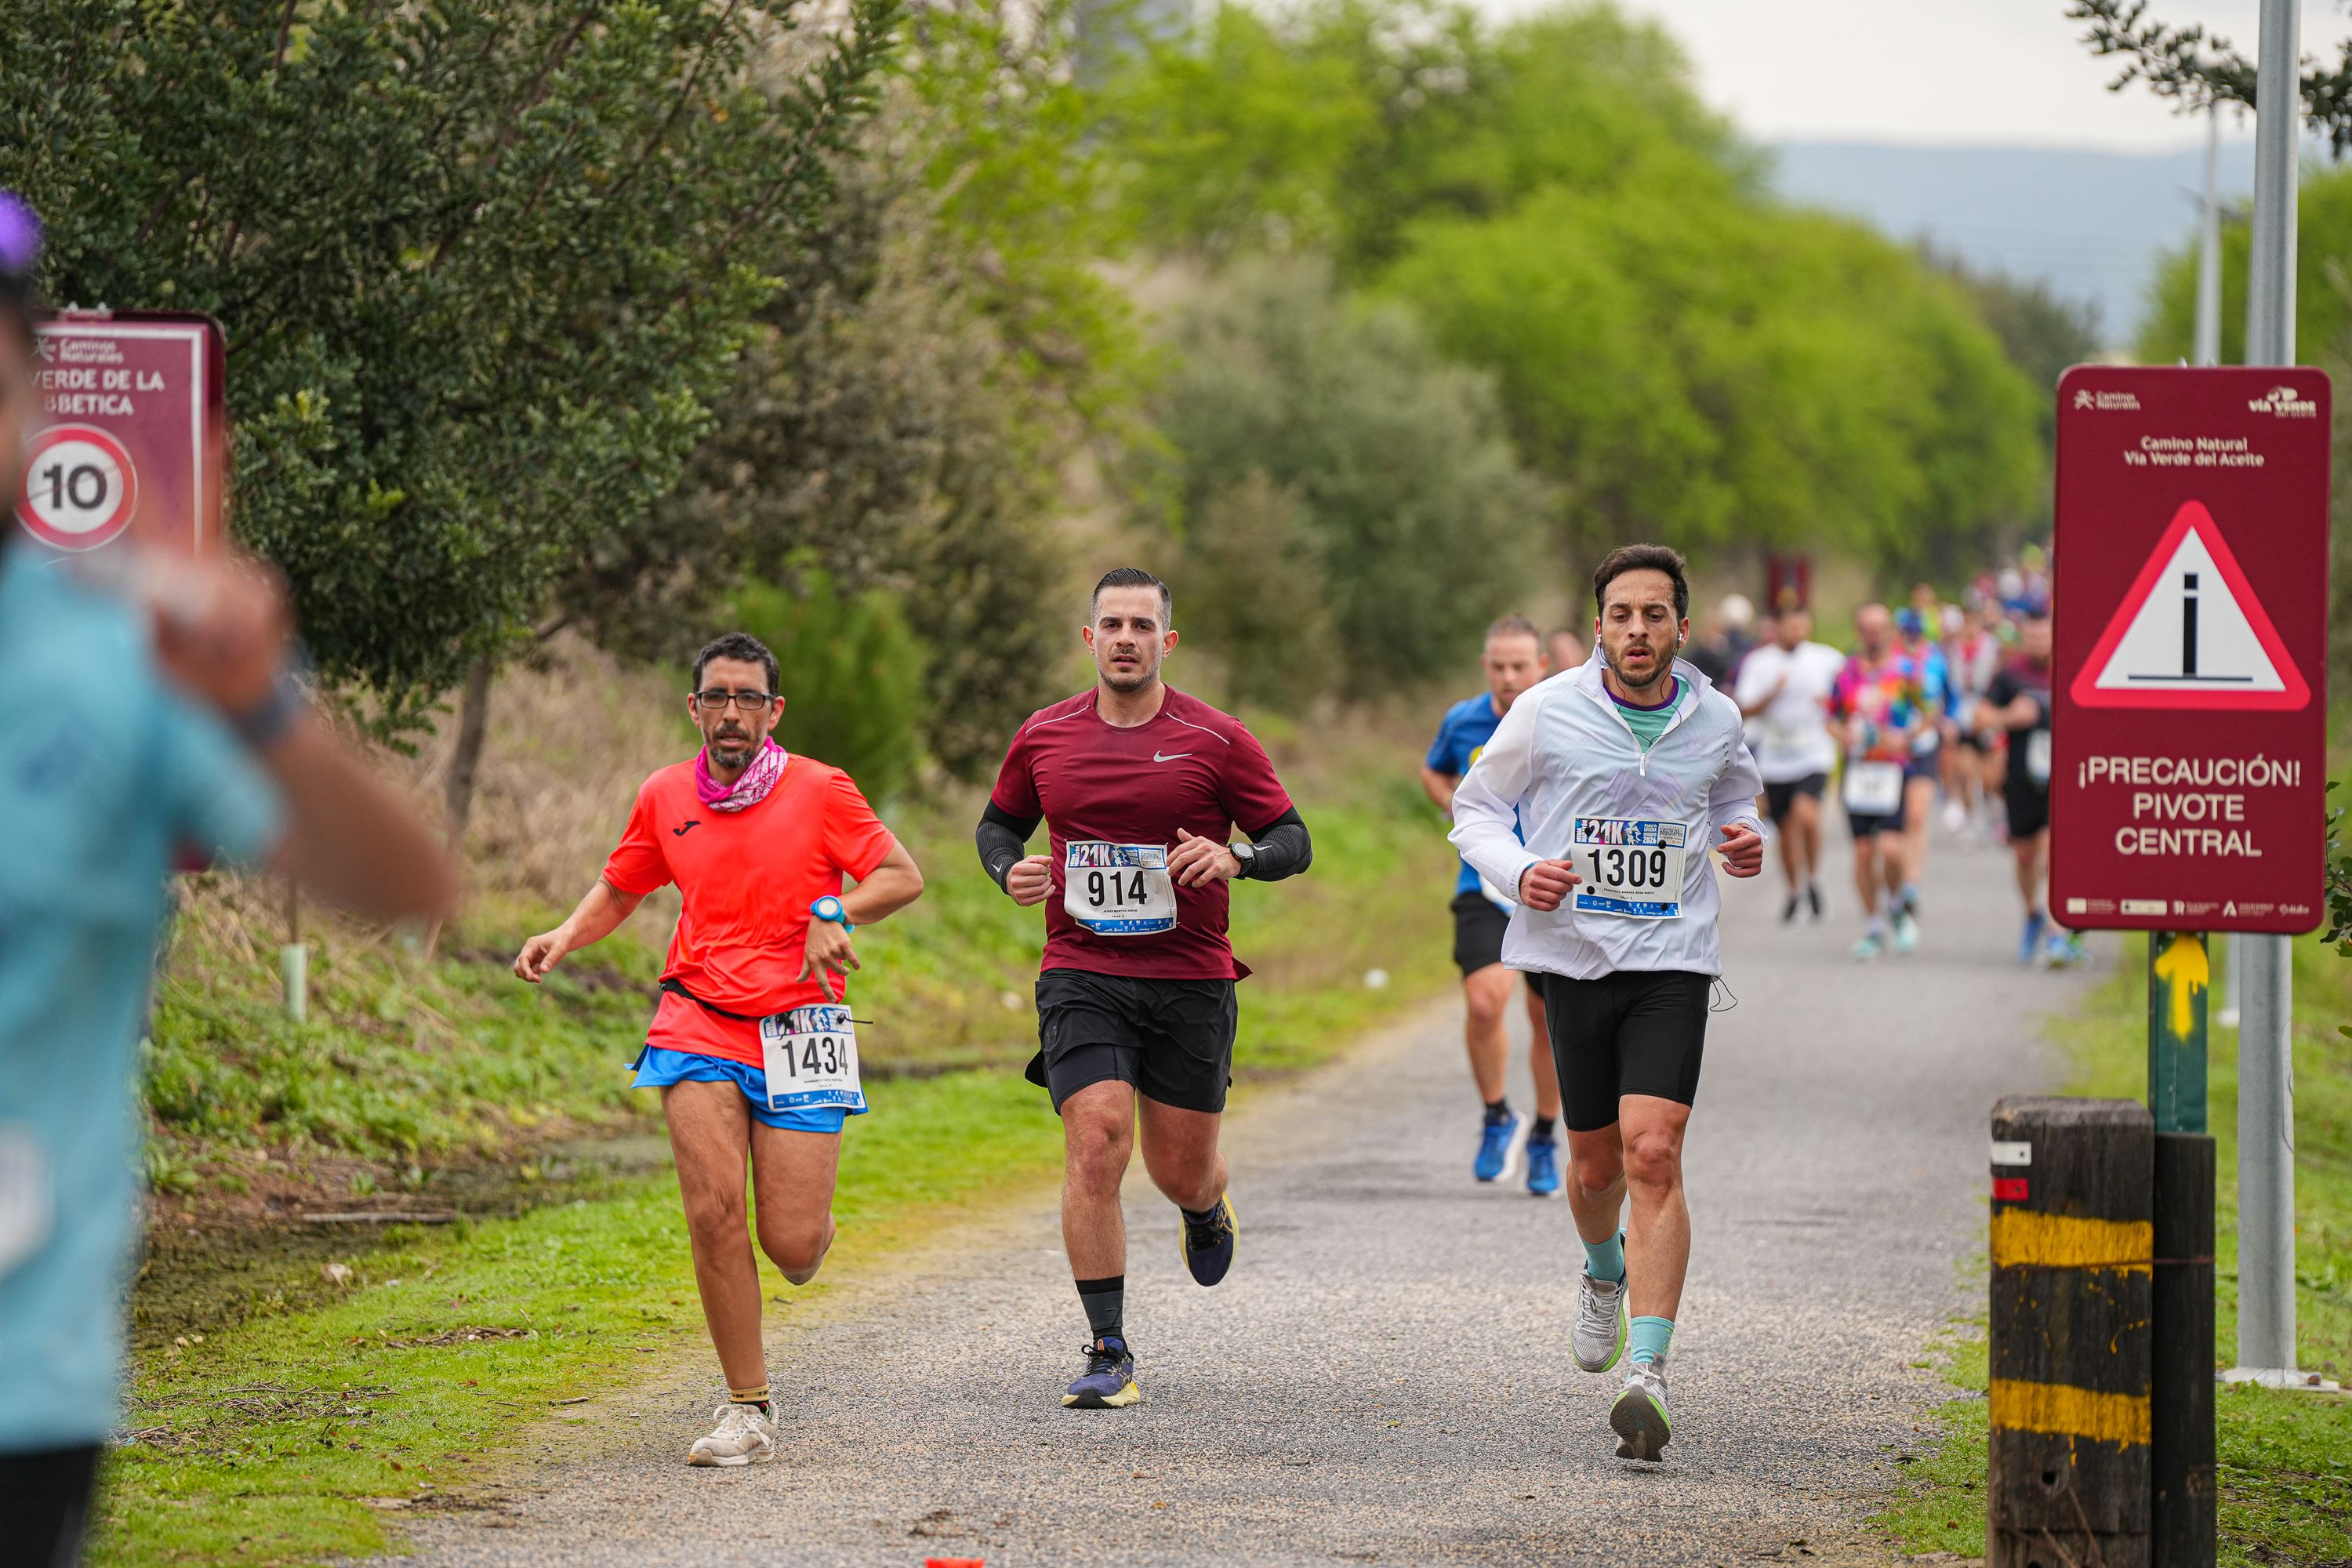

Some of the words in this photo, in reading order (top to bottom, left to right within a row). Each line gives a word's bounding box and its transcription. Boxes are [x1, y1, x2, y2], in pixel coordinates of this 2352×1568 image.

[103, 369, 131, 390] DE
[136, 370, 165, 391] LA
[2140, 435, 2194, 452] Camino
[2196, 436, 2248, 452] Natural
[2150, 451, 2191, 466] Verde
[2194, 451, 2216, 467] del
[2219, 452, 2265, 467] Aceite
[43, 463, 107, 510] 10
[2078, 753, 2301, 789] ¡PRECAUCIÓN!
[2133, 792, 2245, 822] PIVOTE
[1588, 819, 1624, 844] 21K
[2115, 826, 2263, 857] CENTRAL
[1080, 844, 1111, 866] 21K
[1588, 848, 1666, 887] 1309
[1088, 871, 1147, 907] 914
[781, 1036, 848, 1077] 1434
